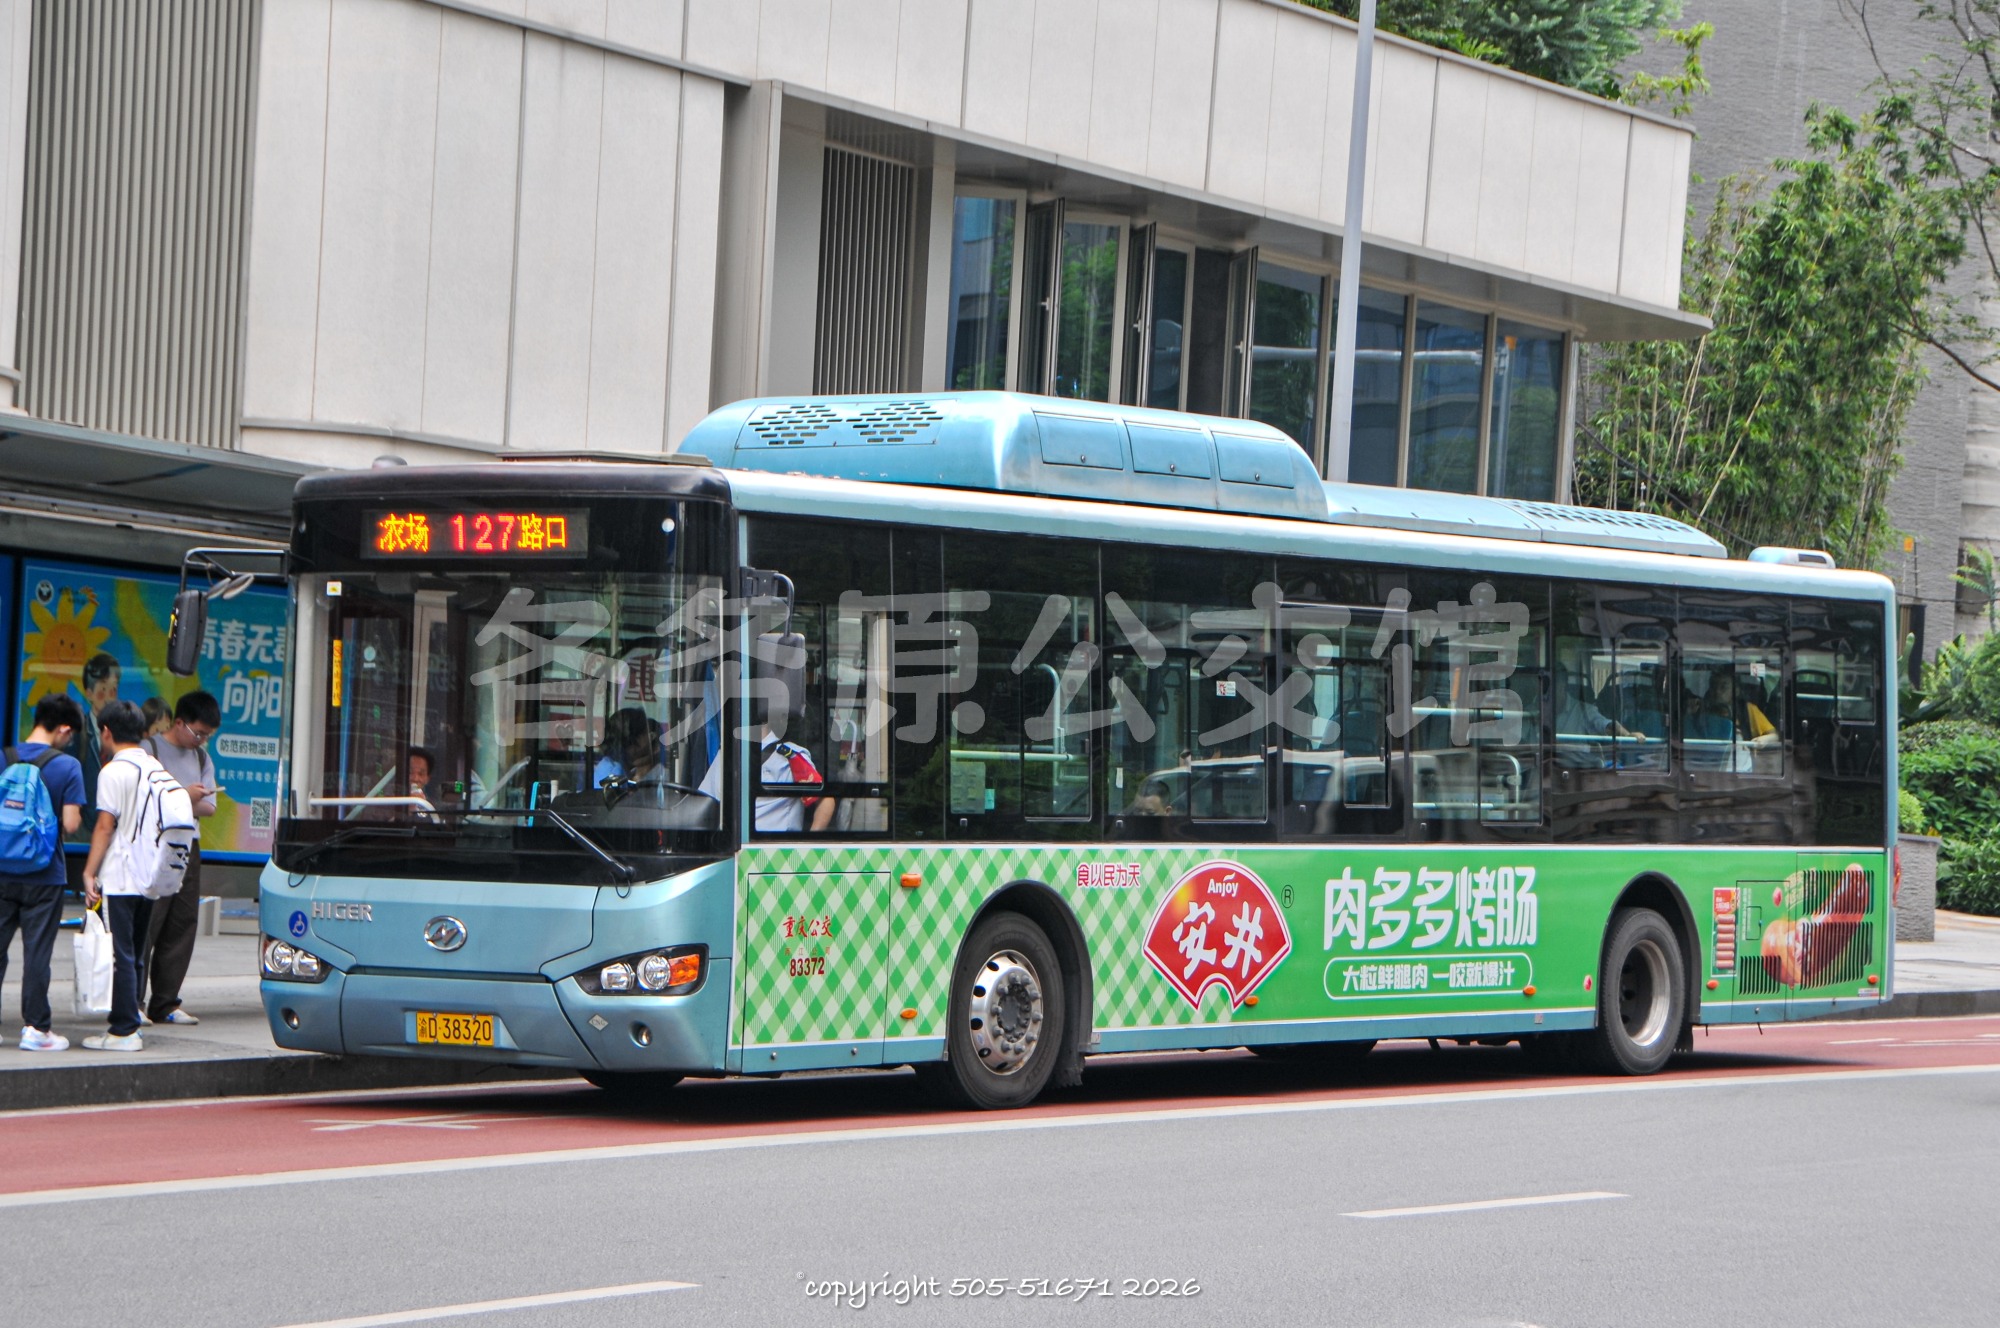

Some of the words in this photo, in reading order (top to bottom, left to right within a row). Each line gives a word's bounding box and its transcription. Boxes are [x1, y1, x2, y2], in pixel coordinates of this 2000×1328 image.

[379, 513, 429, 551] 农场
[453, 515, 515, 549] 127
[517, 513, 566, 550] 路口
[222, 671, 282, 724] 向阳
[220, 739, 275, 755] 防范药物滥用
[1077, 863, 1140, 887] 食以民为天
[1207, 876, 1239, 897] Anjoy
[312, 901, 372, 921] HIGER
[1323, 866, 1538, 950] 肉多多烤肠
[783, 915, 832, 938] 重庆公交
[1172, 901, 1263, 980] 安井
[790, 957, 825, 976] 83372
[1342, 964, 1428, 991] 大粒鲜腿肉
[1432, 961, 1515, 987] 一咬就爆汁
